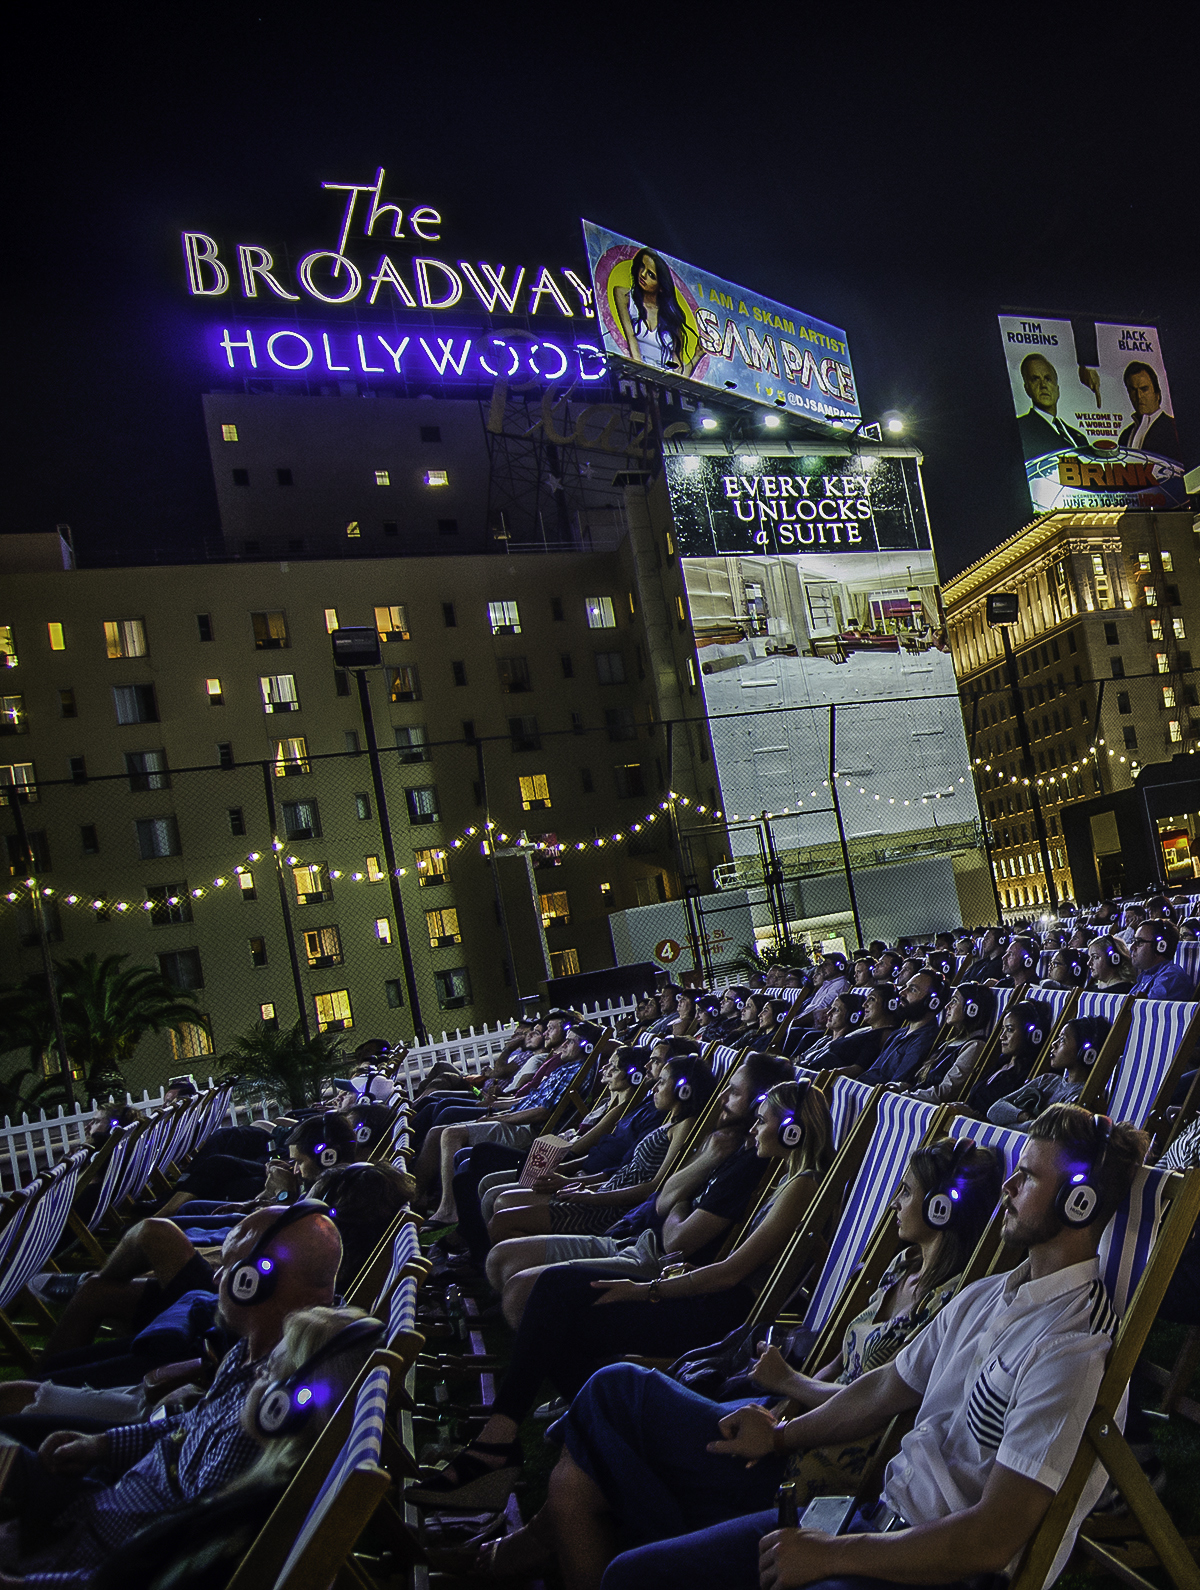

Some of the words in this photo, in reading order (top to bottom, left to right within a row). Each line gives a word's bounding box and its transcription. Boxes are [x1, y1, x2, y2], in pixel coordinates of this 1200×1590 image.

[321, 166, 442, 277] The
[181, 231, 596, 319] BROADWAY
[697, 283, 704, 298] I
[709, 289, 734, 311] AM
[738, 301, 749, 317] A
[752, 306, 796, 335] SKAM
[799, 325, 846, 355] ARTIST
[1020, 321, 1042, 333] TIM
[1006, 332, 1059, 346] ROBBINS
[1118, 340, 1154, 352] BLACK
[1121, 330, 1147, 342] JACK
[219, 328, 608, 380] HOLLYWOOD
[1075, 412, 1111, 420] WELCOME
[1112, 413, 1123, 421] TO
[1085, 428, 1118, 436] TROUBLE
[1058, 463, 1161, 486] BRINK
[723, 475, 811, 498] EVERY
[823, 475, 872, 498] KEY
[734, 499, 872, 522] UNLOCKS
[754, 529, 770, 545] a
[779, 522, 863, 544] SUITE
[713, 929, 725, 939] St
[661, 942, 674, 959] 4
